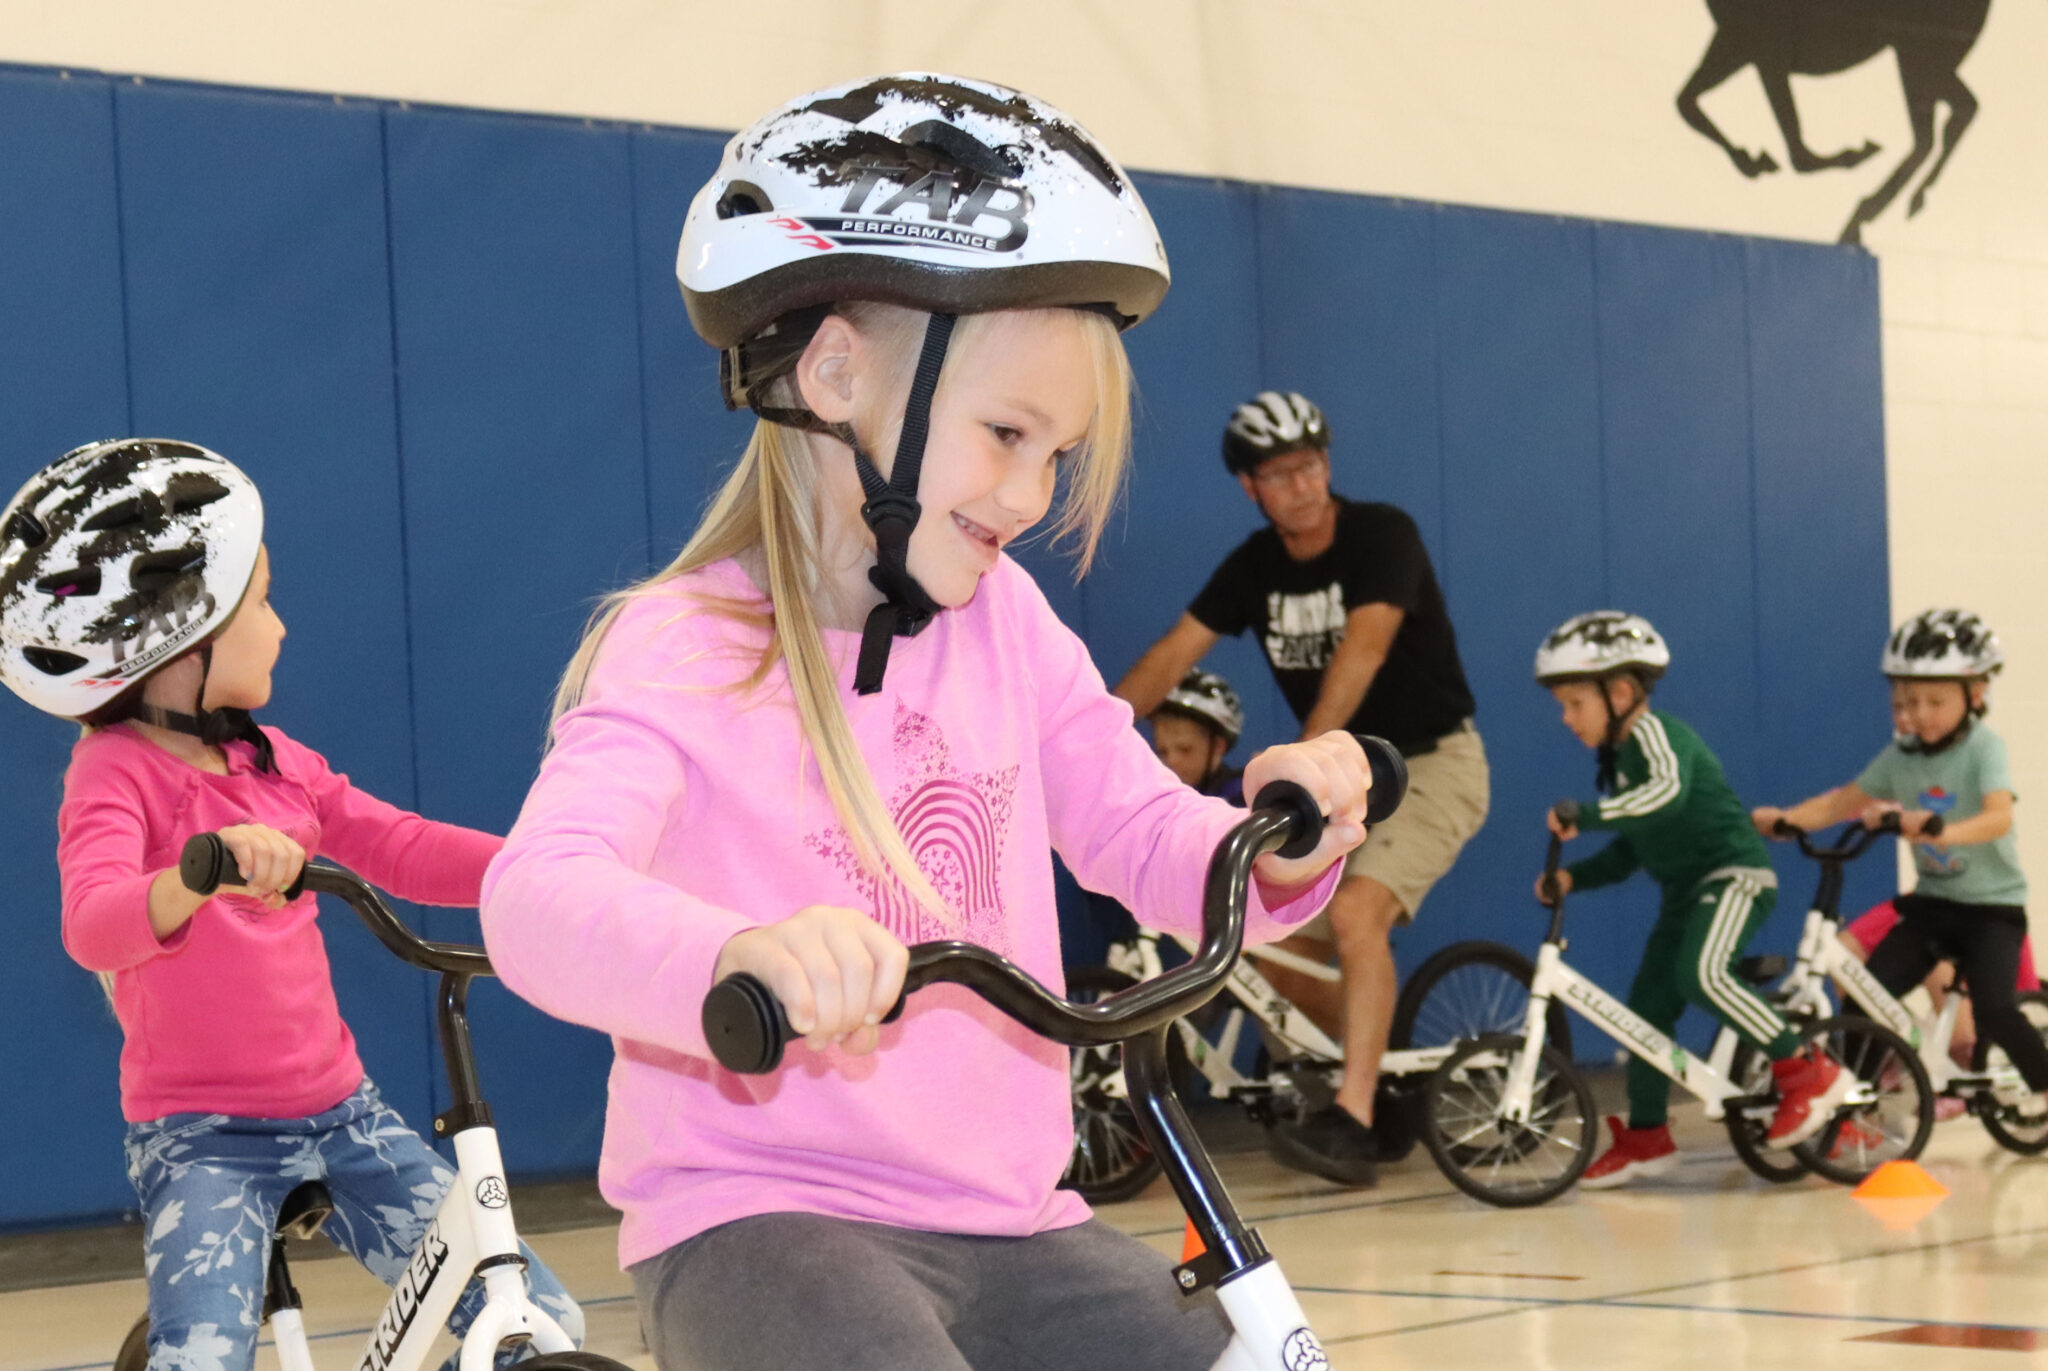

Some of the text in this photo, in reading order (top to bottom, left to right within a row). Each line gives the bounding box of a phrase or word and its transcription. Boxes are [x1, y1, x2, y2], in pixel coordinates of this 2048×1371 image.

[840, 166, 1035, 252] TAB
[841, 220, 998, 251] PERFORMANCE
[120, 614, 208, 673] PERFORMANCE
